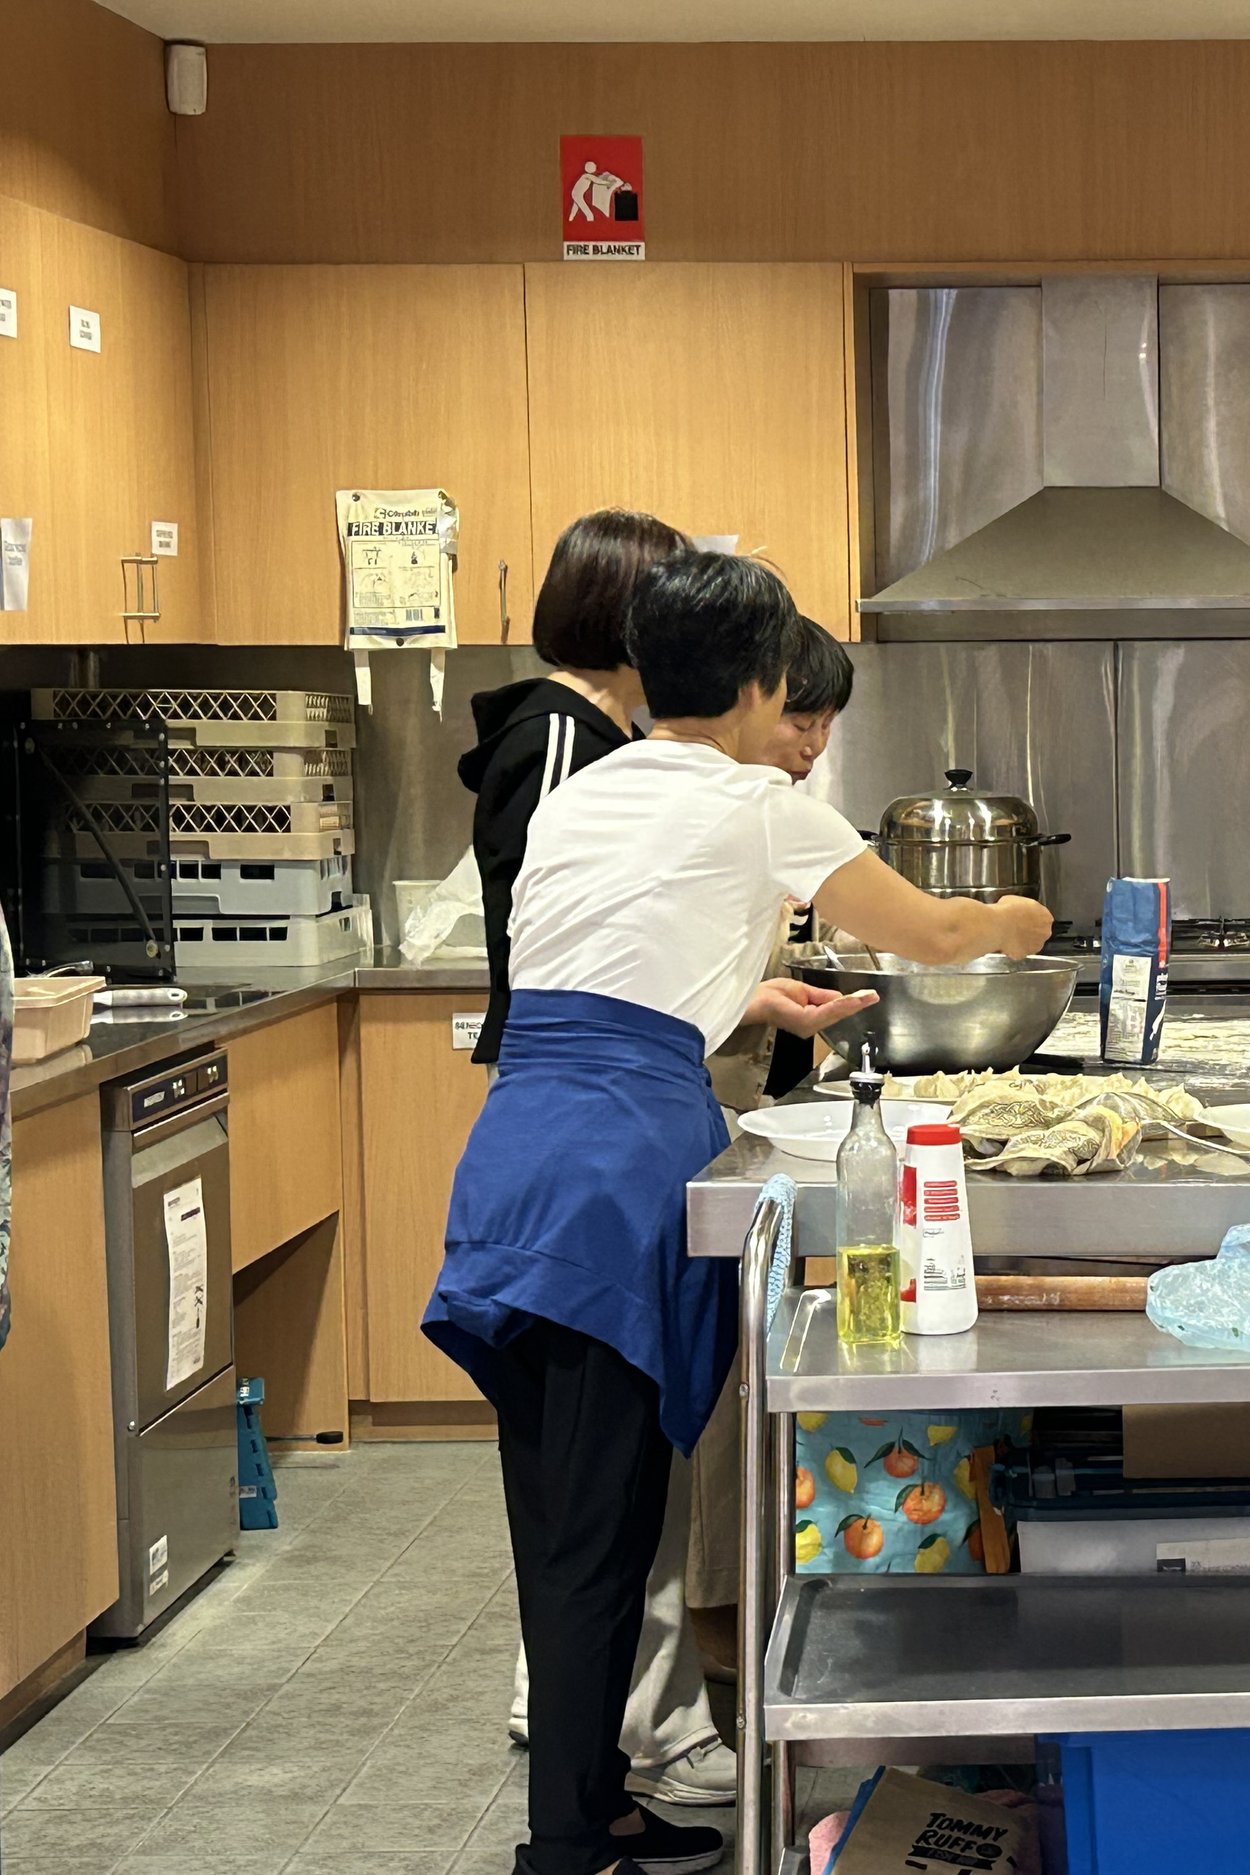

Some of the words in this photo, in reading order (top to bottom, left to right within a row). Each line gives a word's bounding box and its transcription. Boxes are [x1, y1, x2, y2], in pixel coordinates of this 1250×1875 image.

[565, 244, 590, 256] FIRE
[592, 244, 642, 256] BLANKET
[351, 521, 380, 536] FIRE
[382, 520, 439, 536] BLANKE
[926, 1812, 1009, 1843] TOMMY
[915, 1829, 978, 1854] RUFF
